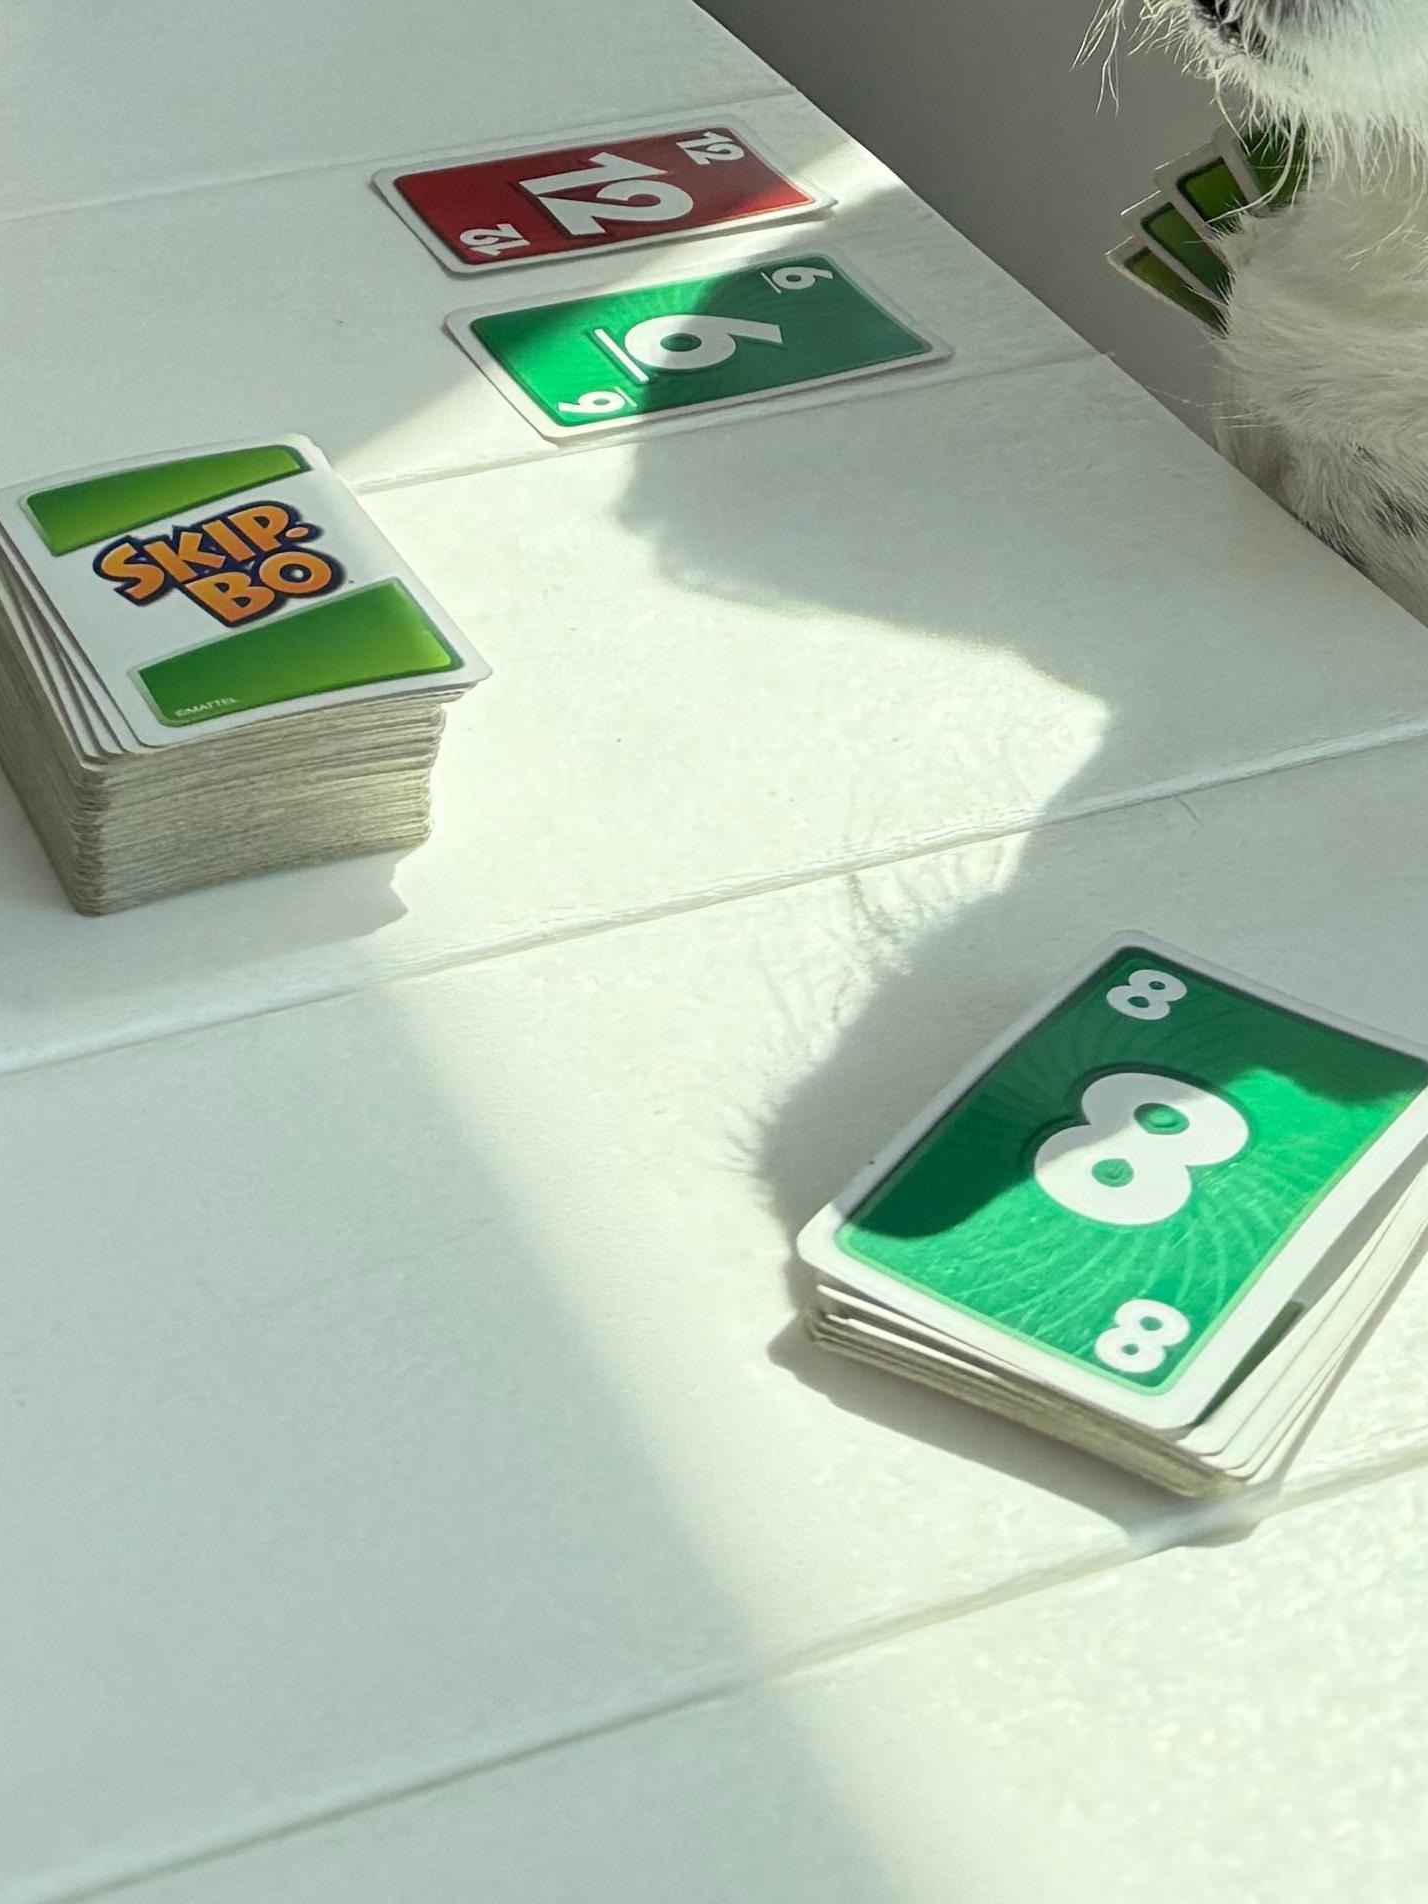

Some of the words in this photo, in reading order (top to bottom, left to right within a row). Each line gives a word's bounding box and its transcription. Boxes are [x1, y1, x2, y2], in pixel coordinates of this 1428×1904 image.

[675, 130, 745, 166] 12
[518, 151, 694, 236] 12
[459, 223, 531, 257] 12
[622, 313, 783, 374] 6
[184, 550, 333, 623] BO
[1105, 969, 1188, 1021] 8
[1034, 1072, 1249, 1227] 8
[1094, 1298, 1190, 1374] 8
